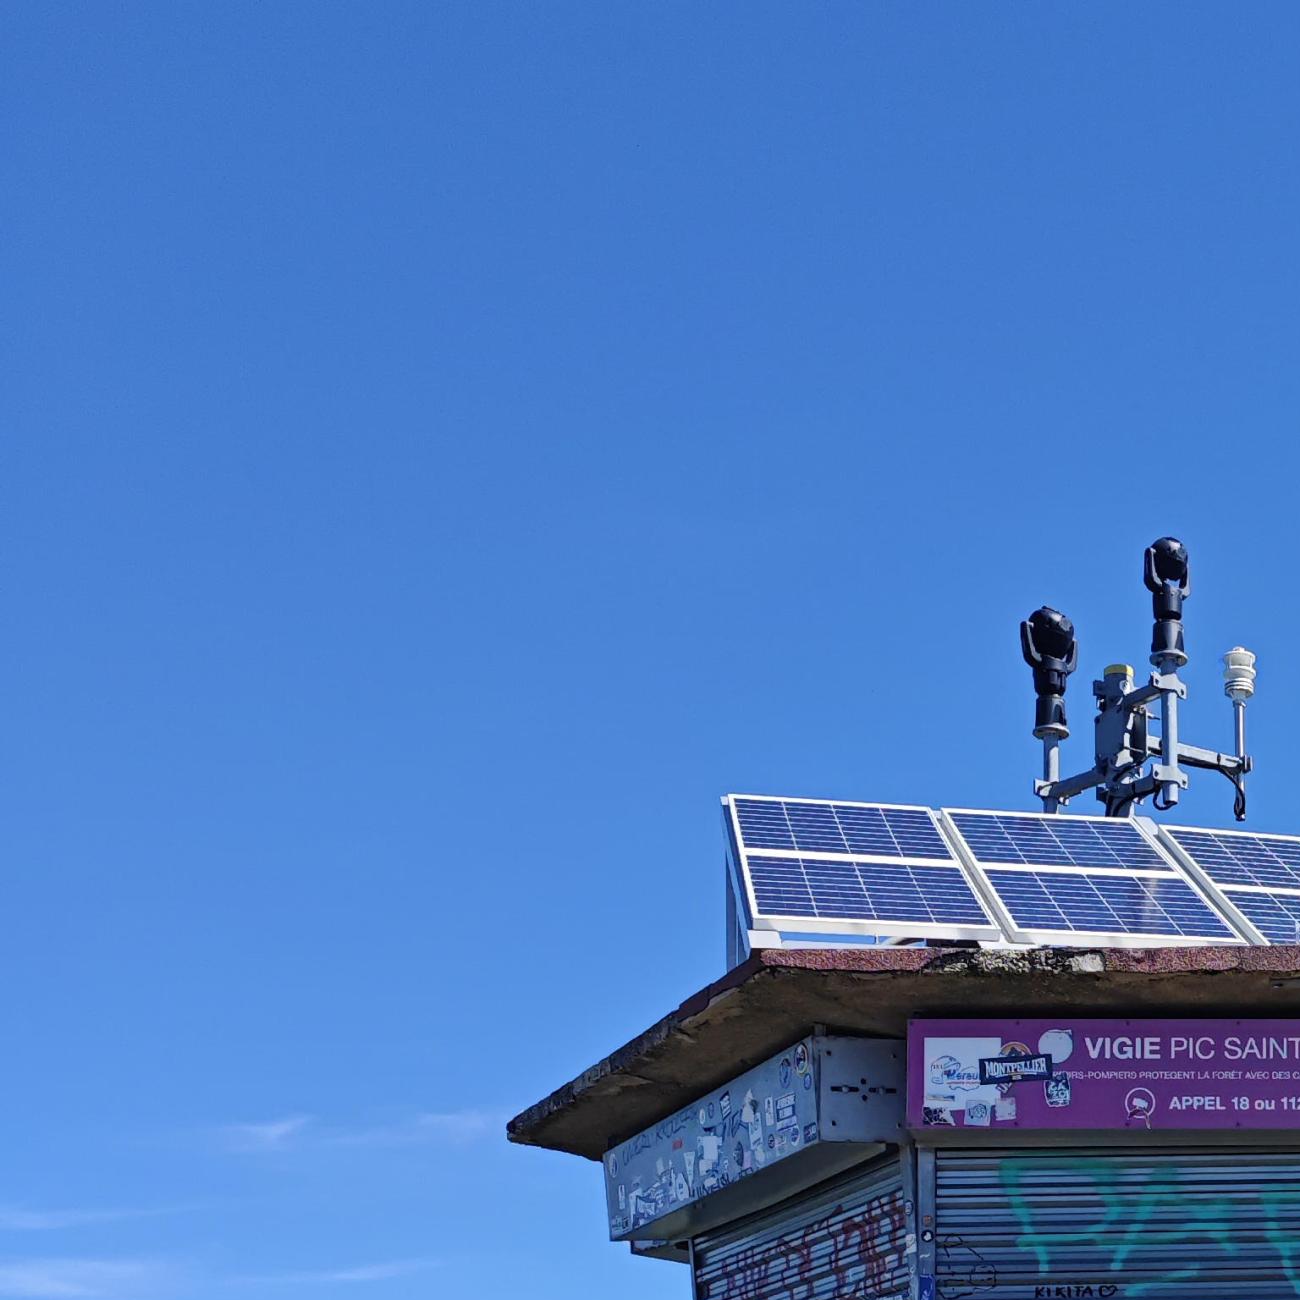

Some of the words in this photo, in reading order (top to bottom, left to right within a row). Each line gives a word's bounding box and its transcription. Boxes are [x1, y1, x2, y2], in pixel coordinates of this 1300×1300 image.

[1085, 1037, 1161, 1059] VIGIE
[1170, 1037, 1215, 1060] PIC
[984, 1058, 1047, 1078] MONTPELLIER
[1197, 1071, 1210, 1080] LA
[1244, 1071, 1270, 1080] AVEC
[1271, 1071, 1290, 1080] DES
[1169, 1096, 1226, 1110] APPEL
[1231, 1096, 1250, 1110] 18
[1254, 1099, 1275, 1110] ou
